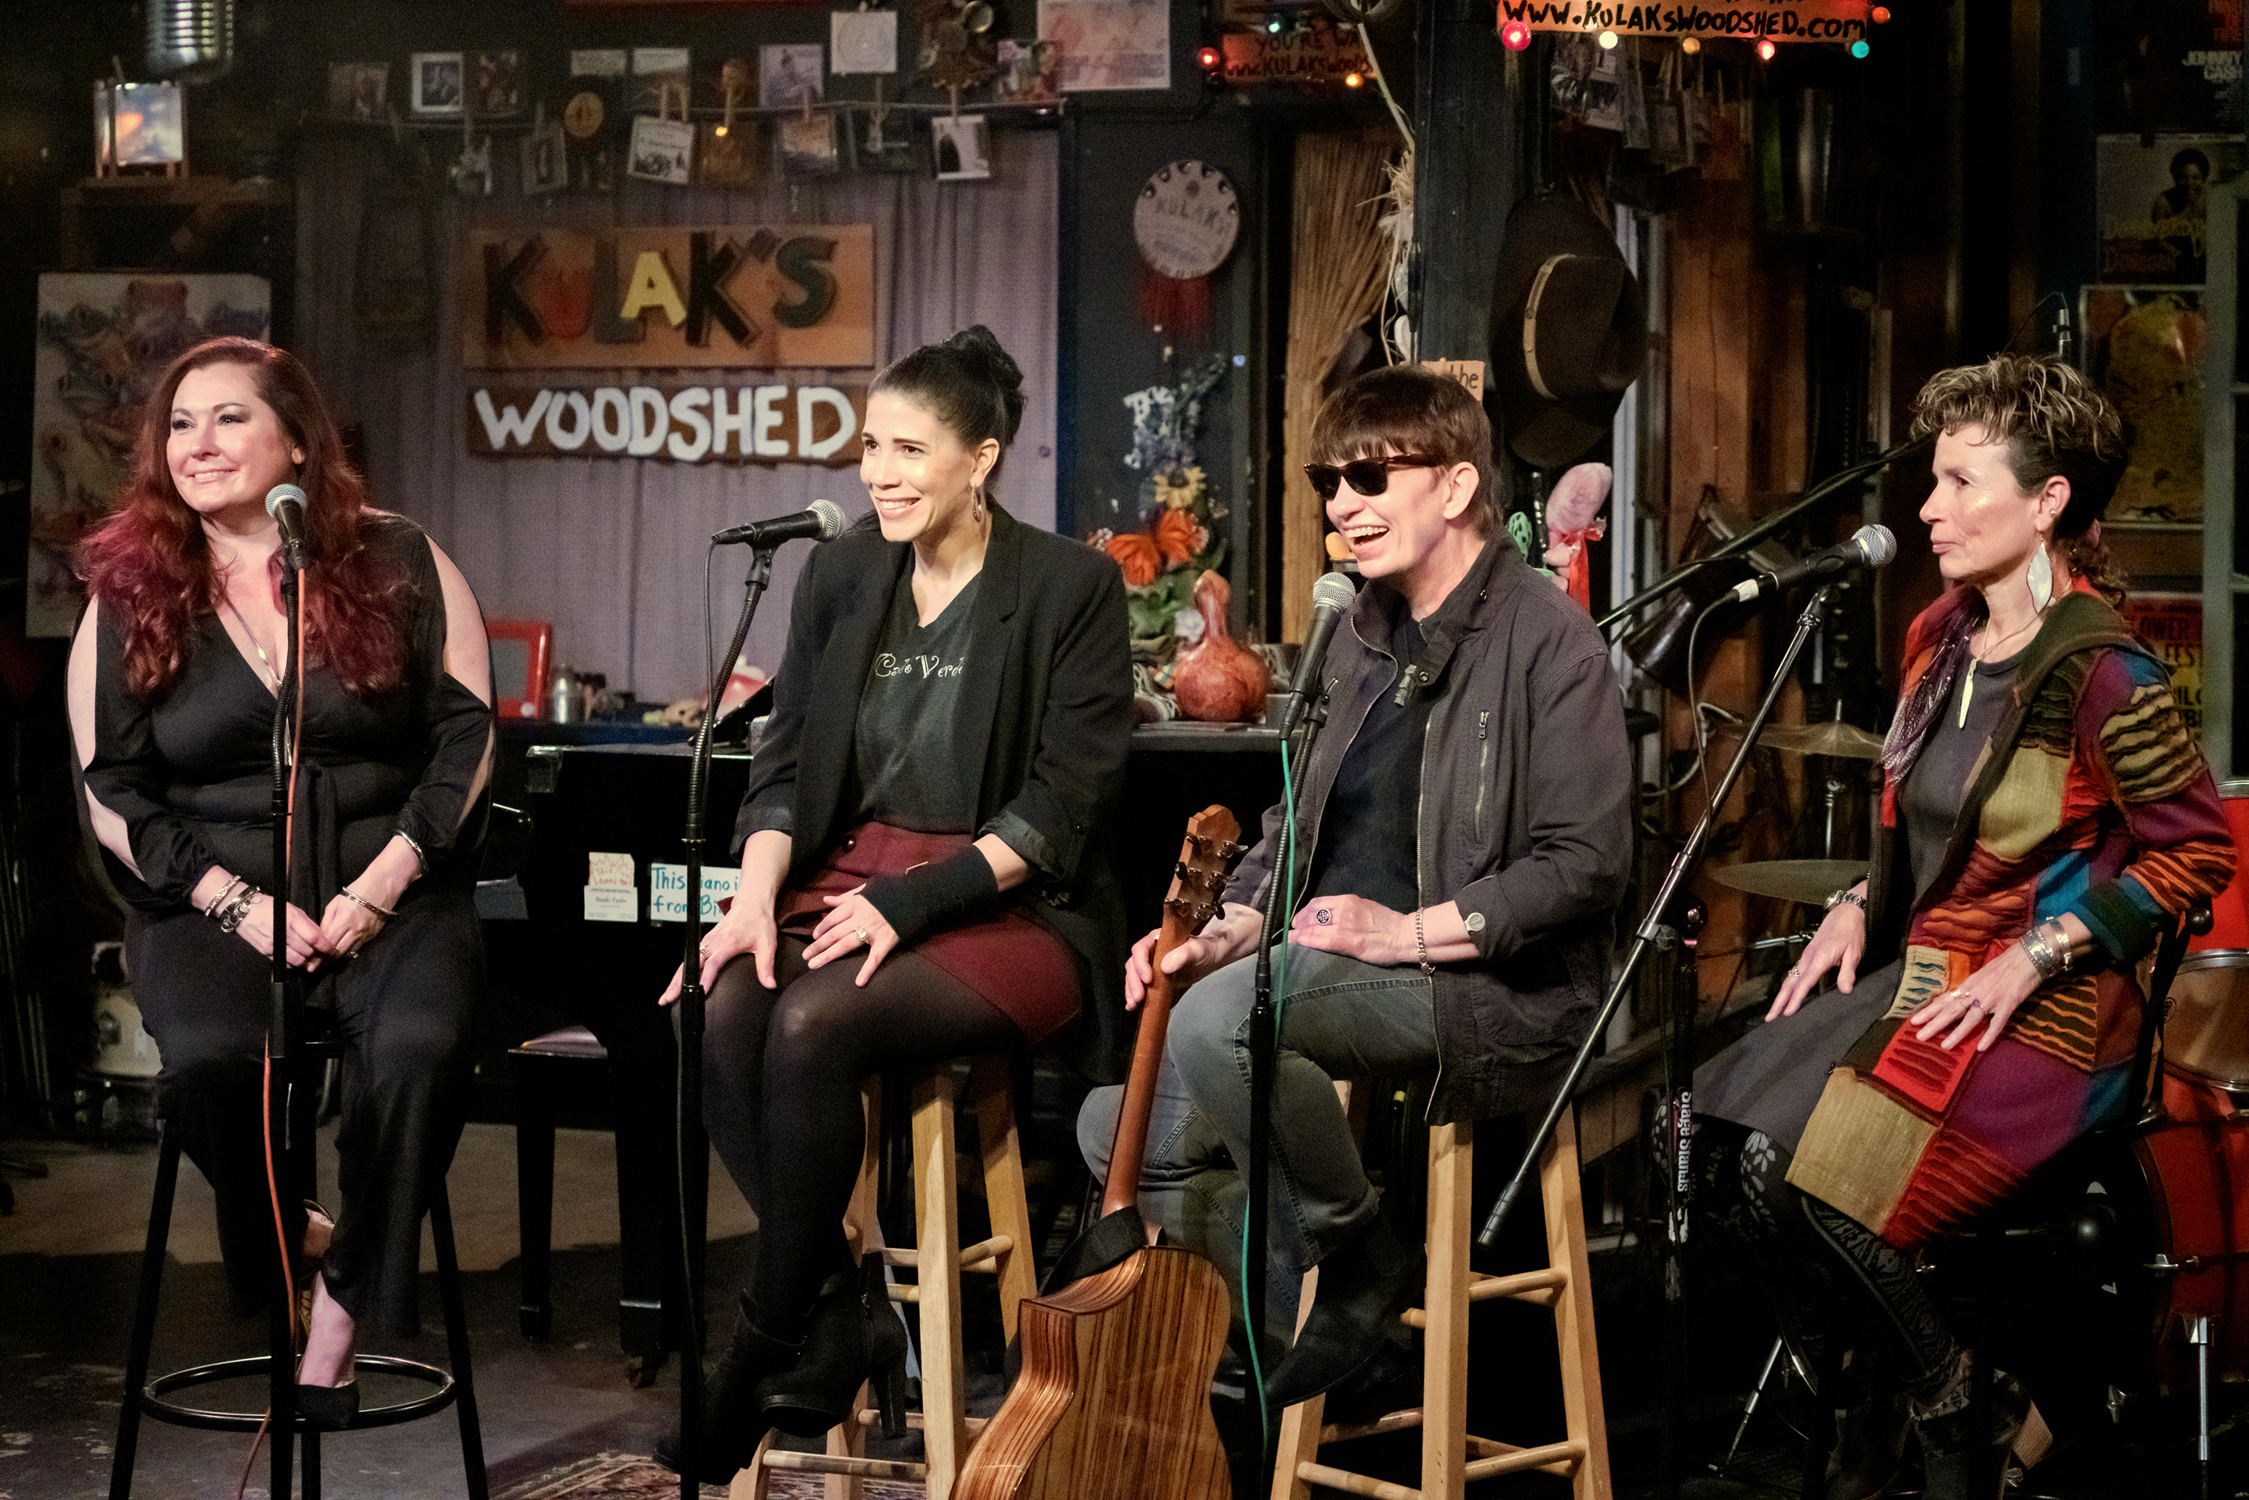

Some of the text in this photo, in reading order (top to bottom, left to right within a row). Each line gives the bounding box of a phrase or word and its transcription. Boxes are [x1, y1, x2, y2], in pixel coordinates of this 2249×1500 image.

[483, 229, 838, 348] KULAK'S
[474, 385, 857, 461] WOODSHED
[652, 867, 686, 890] This
[700, 874, 730, 891] iano
